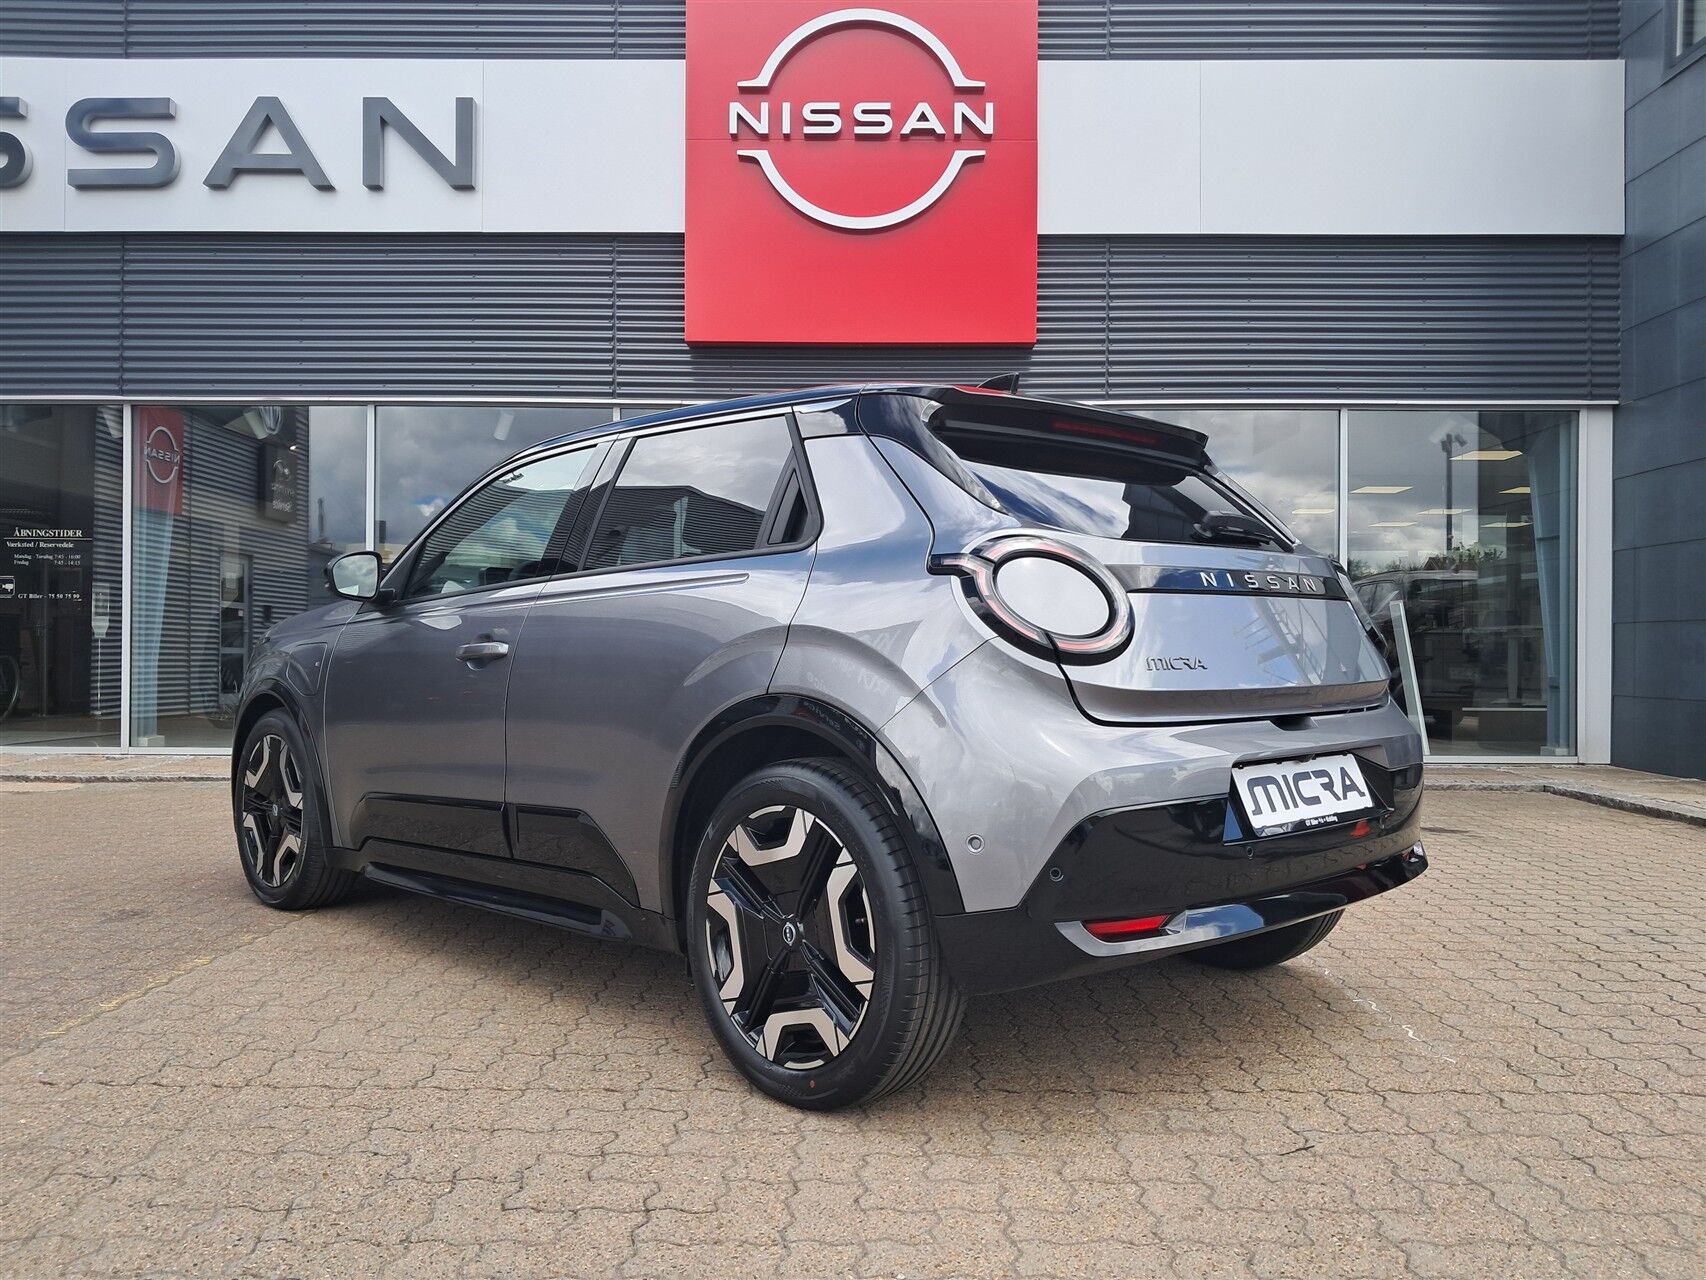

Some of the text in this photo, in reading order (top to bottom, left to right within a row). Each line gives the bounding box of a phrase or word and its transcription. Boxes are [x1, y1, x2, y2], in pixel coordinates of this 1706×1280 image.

[728, 101, 994, 138] NISSAN
[13, 527, 83, 537] ÅBNINGSTIDER
[1199, 571, 1319, 592] NISSAN
[1145, 655, 1208, 671] MICRA
[1246, 766, 1366, 816] MICRA
